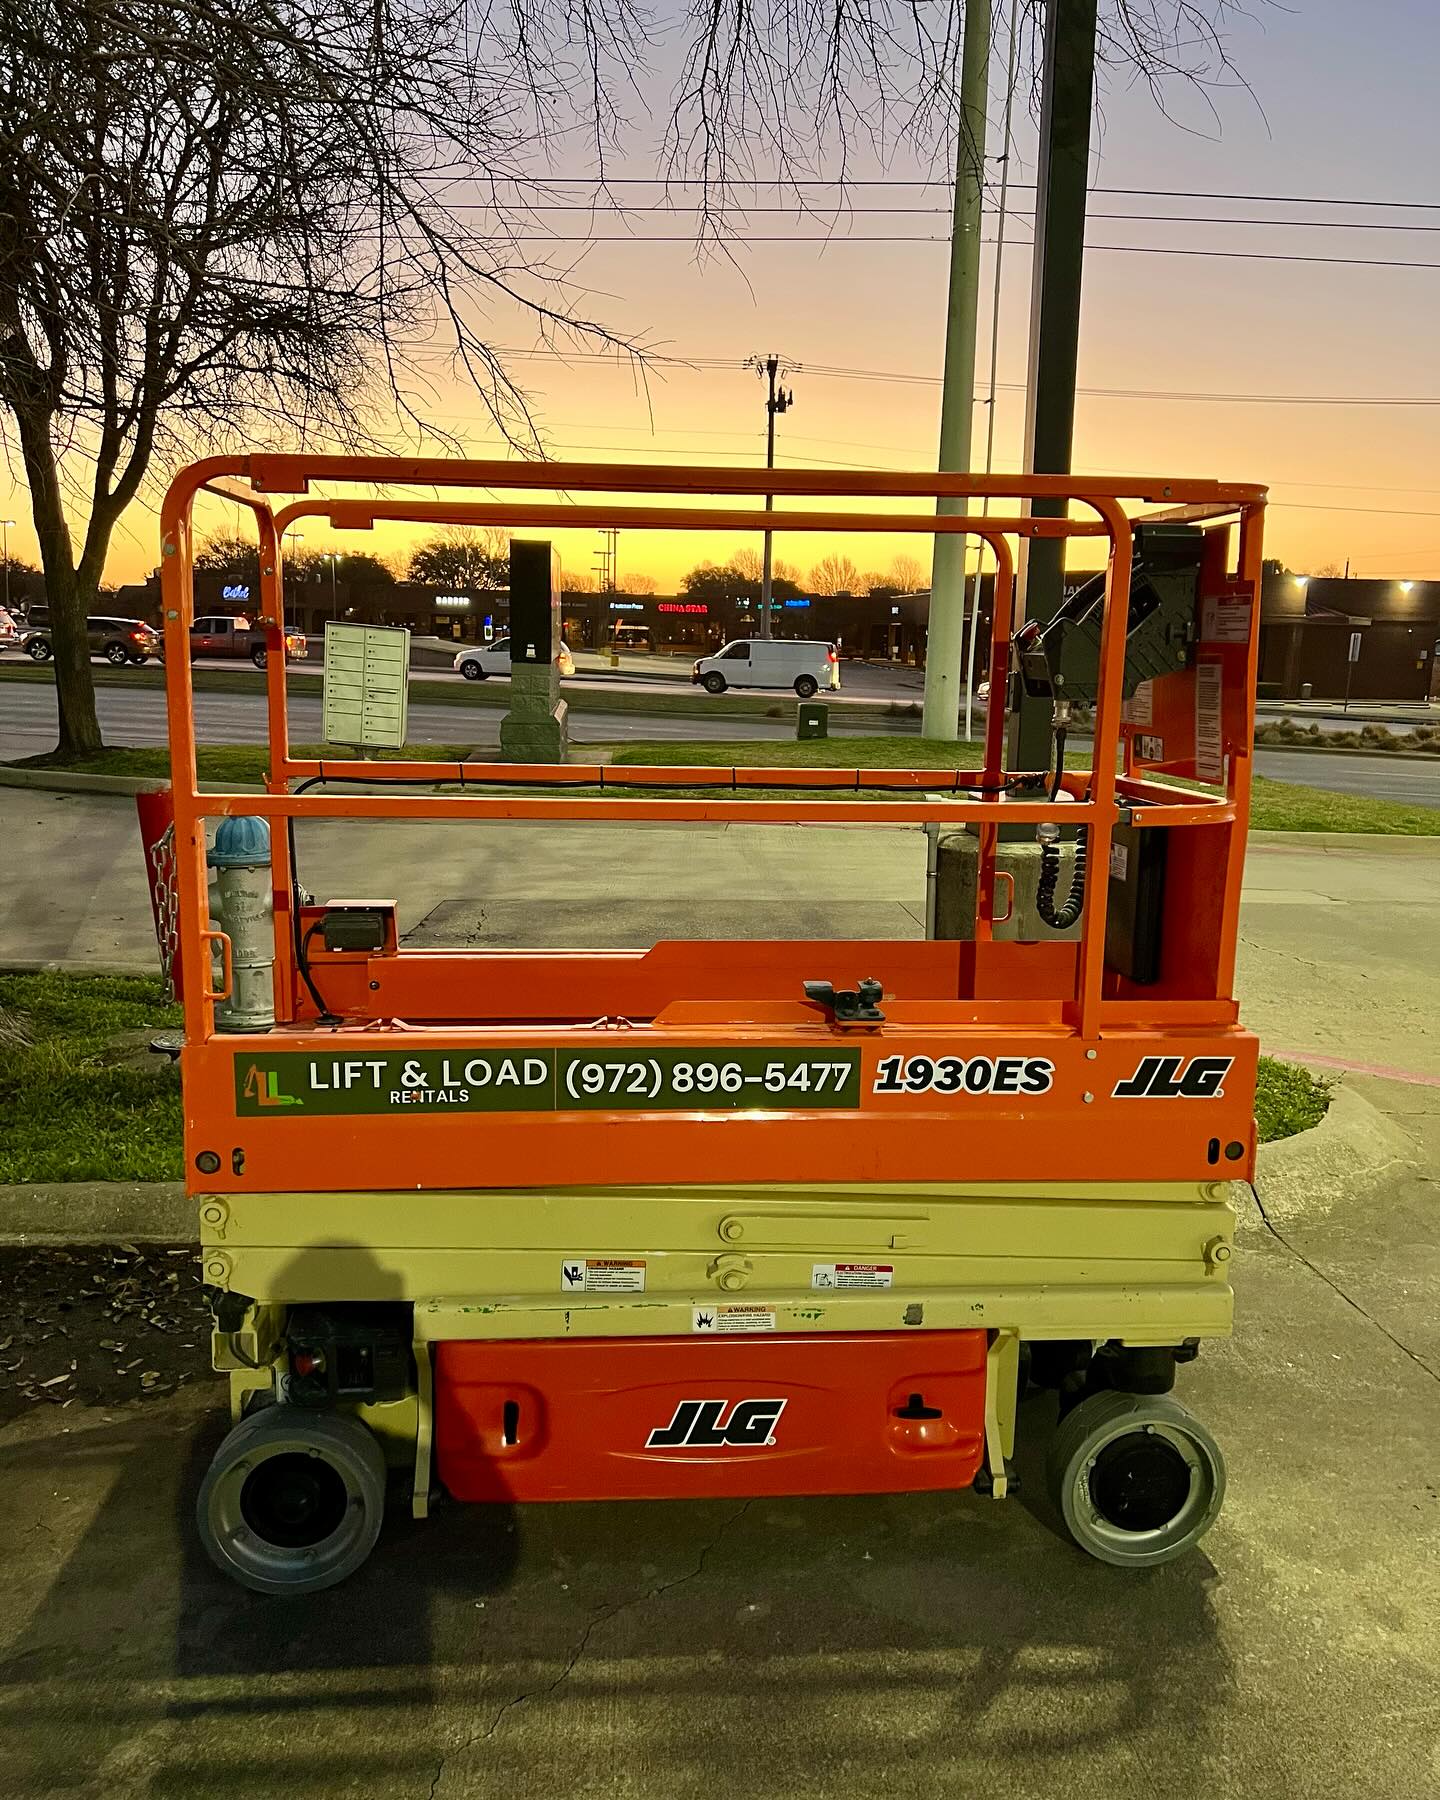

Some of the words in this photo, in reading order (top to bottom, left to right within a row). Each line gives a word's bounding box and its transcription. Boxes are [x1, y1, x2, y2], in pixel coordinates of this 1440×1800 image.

[658, 603, 684, 612] CHINA
[685, 604, 708, 613] STAR
[310, 1061, 387, 1089] LIFT
[400, 1059, 429, 1088] &
[443, 1058, 548, 1086] LOAD
[566, 1059, 662, 1098] (972)
[671, 1062, 852, 1093] 896-5477
[872, 1055, 1056, 1095] 1930ES
[1111, 1056, 1236, 1098] JLG
[390, 1089, 469, 1104] RENTALS
[645, 1399, 788, 1448] JLG
